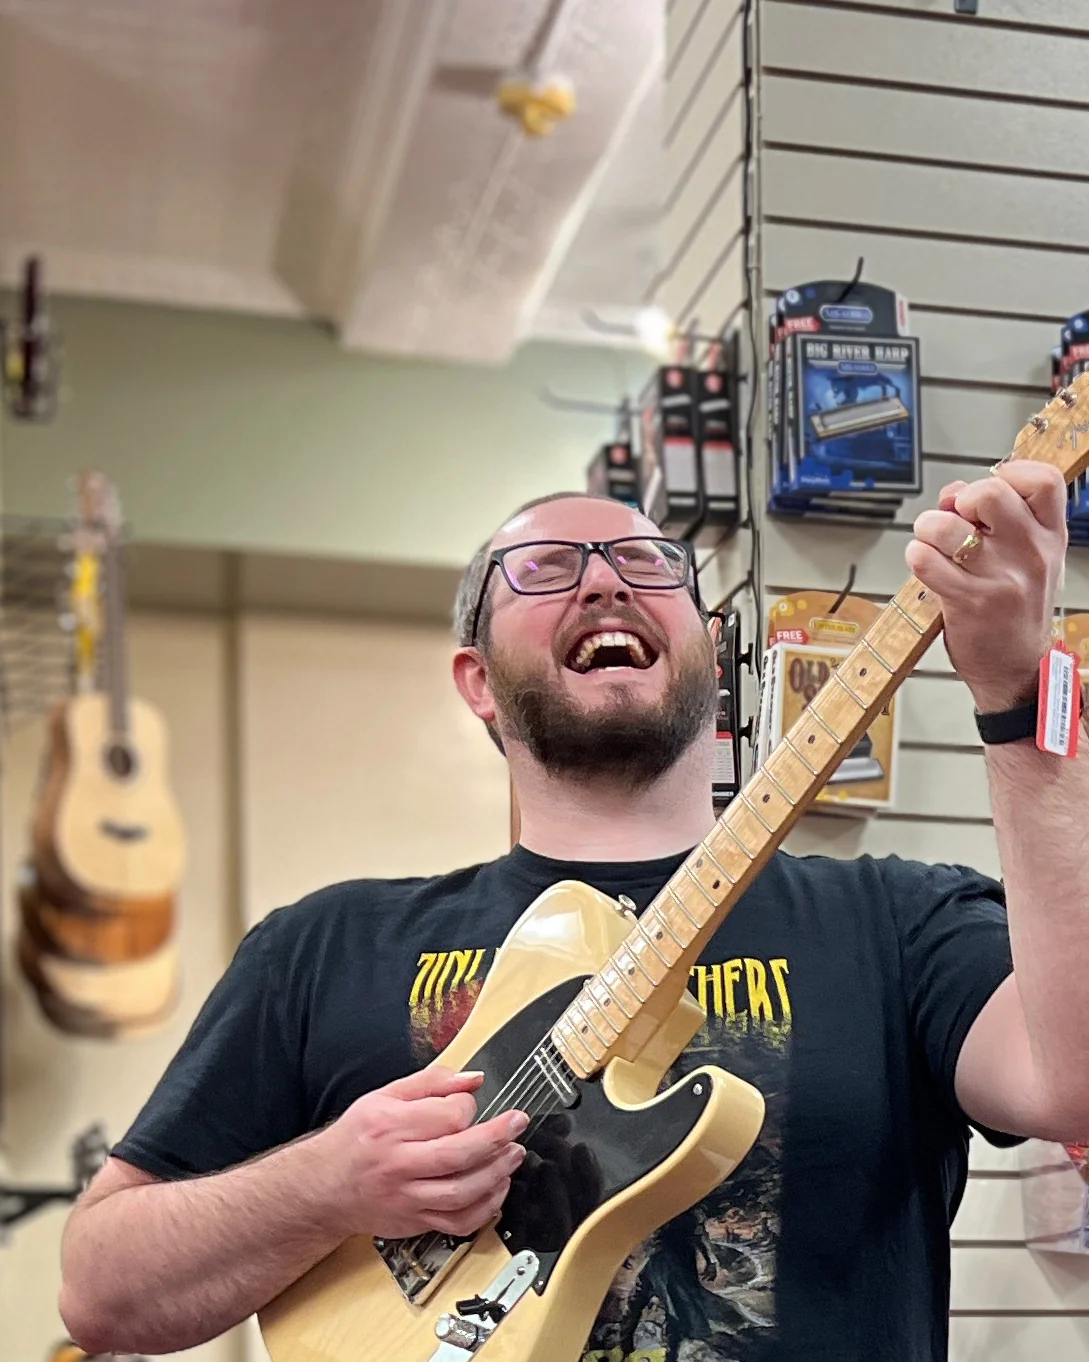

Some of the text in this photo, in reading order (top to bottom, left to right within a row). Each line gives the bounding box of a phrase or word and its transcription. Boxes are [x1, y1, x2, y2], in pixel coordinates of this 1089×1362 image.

[806, 342, 909, 362] BIG RIVER HARP
[776, 630, 804, 641] FREE
[789, 656, 831, 694] OLD
